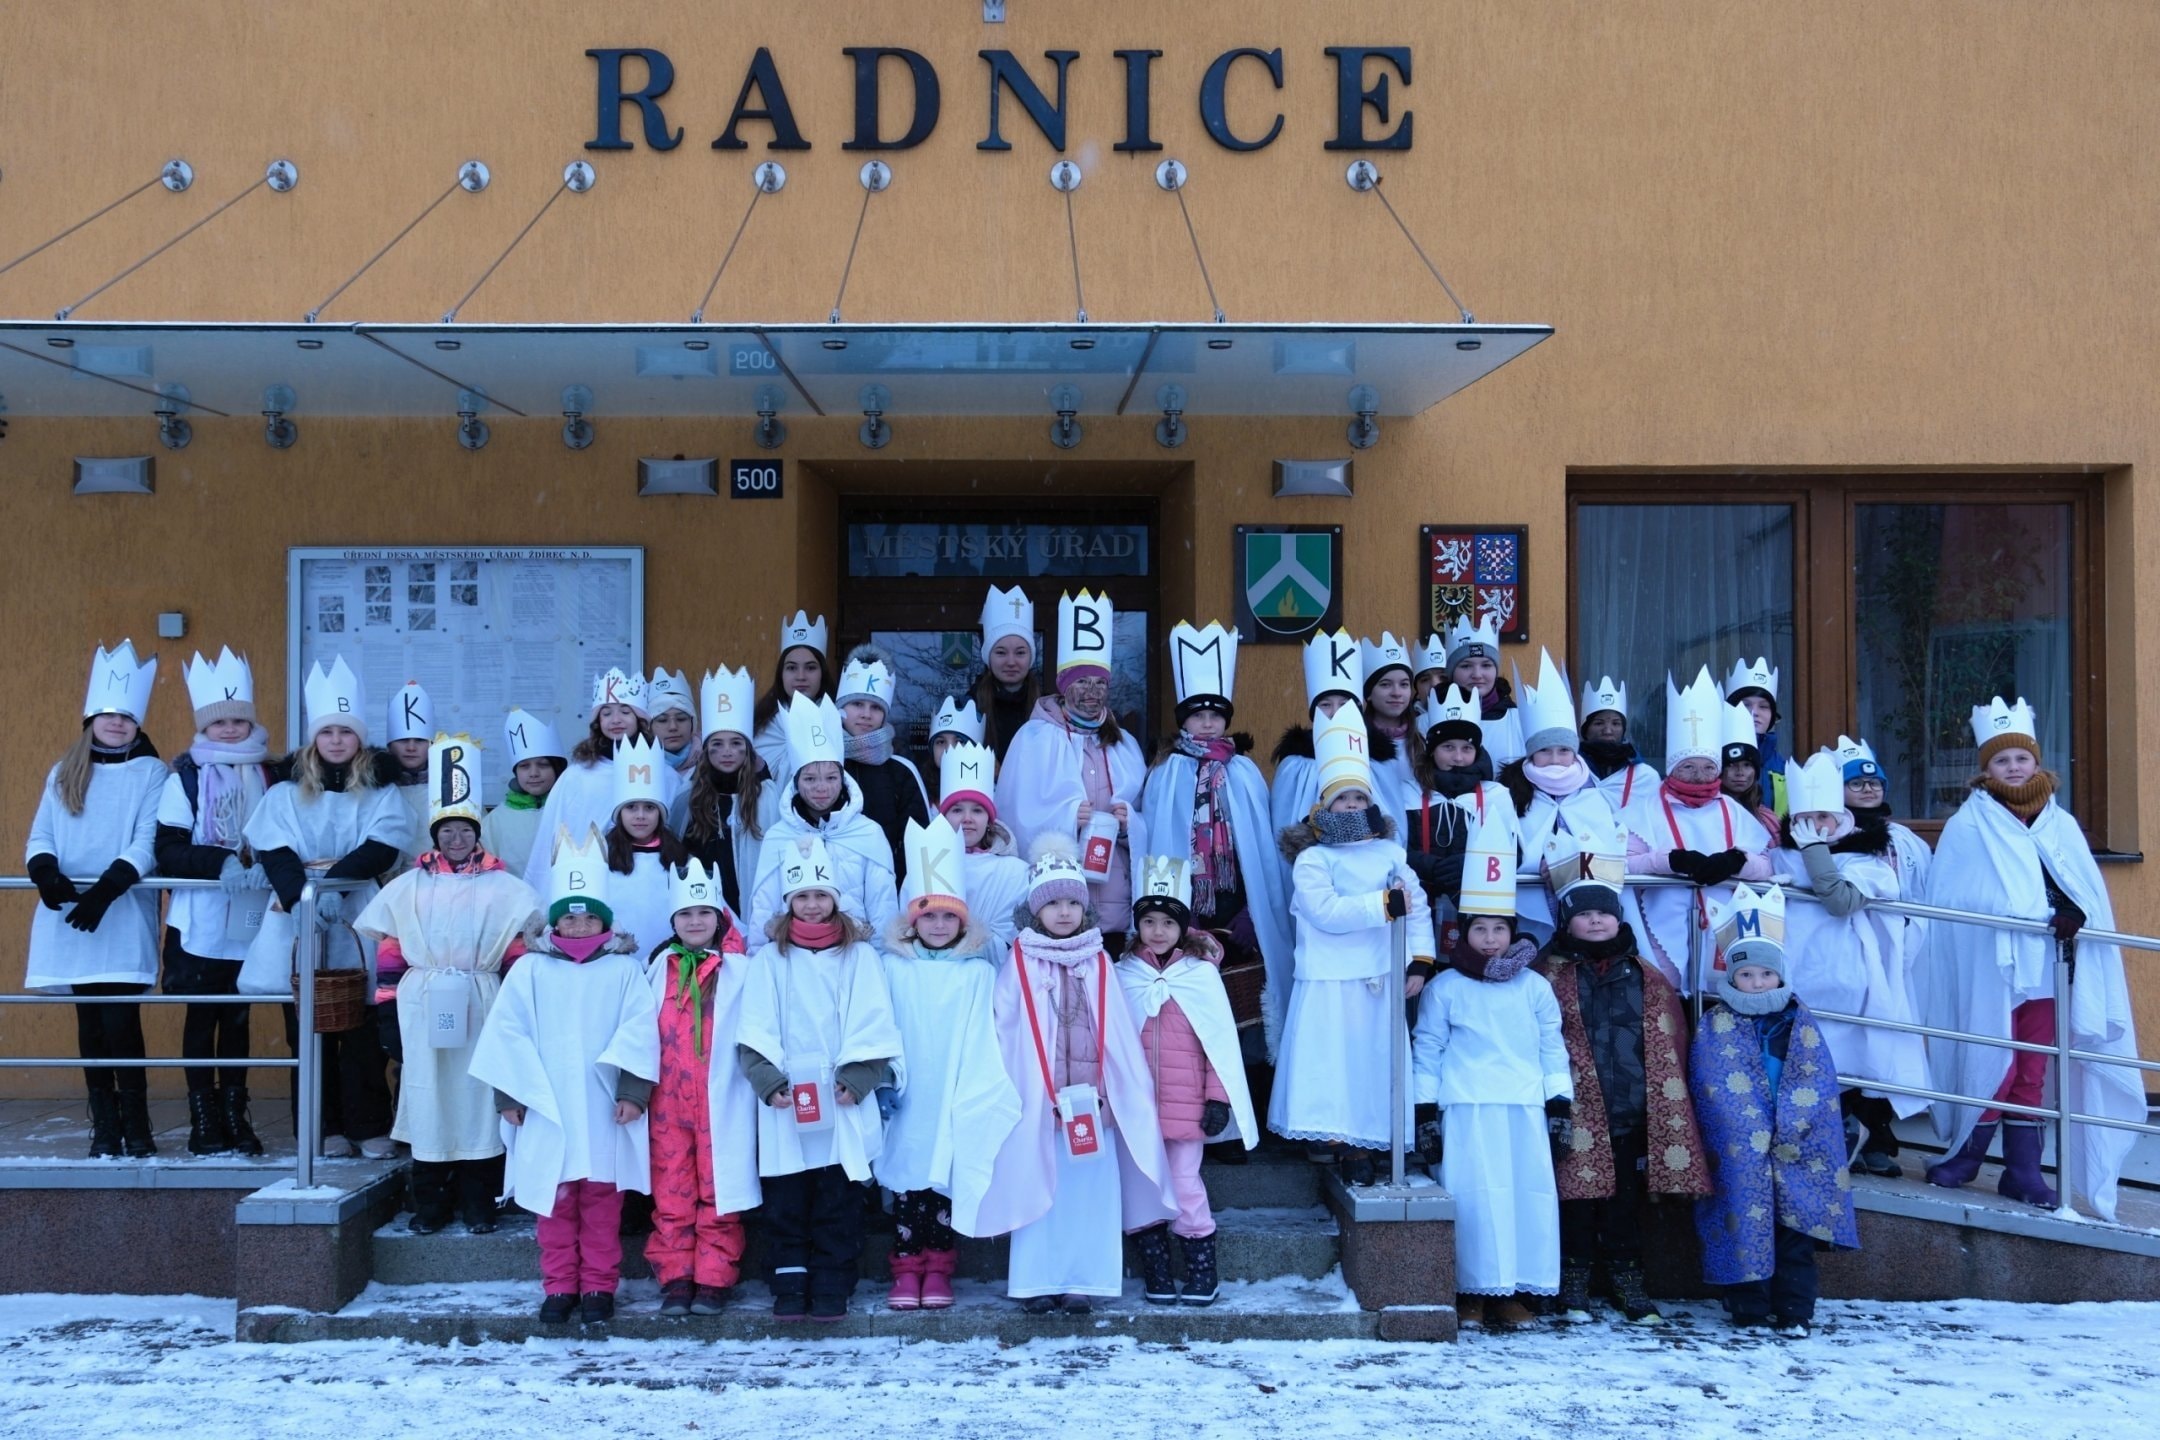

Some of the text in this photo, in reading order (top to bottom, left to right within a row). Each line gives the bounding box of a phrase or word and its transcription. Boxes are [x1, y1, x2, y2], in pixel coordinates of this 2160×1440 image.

[584, 47, 1413, 151] RADNICE
[737, 468, 776, 490] 500
[343, 549, 382, 559] ÚŘEDNÍ
[387, 551, 420, 559] DESKA
[424, 549, 485, 559] MĚSTSKÉHO
[489, 549, 524, 559] ÚŘADU
[864, 528, 1135, 559] MĚSTSKÝ ÚŘAD
[1073, 605, 1104, 651] B
[1178, 636, 1223, 697] M
[1331, 641, 1355, 680] K
[108, 669, 131, 694] M
[225, 686, 238, 701] K
[606, 677, 620, 703] K
[866, 674, 880, 692] K
[338, 697, 351, 713] B
[404, 693, 426, 731] K
[718, 693, 732, 712] B
[509, 723, 527, 755] M
[811, 725, 827, 747] B
[1349, 734, 1362, 754] M
[441, 746, 470, 808] B
[628, 765, 652, 783] M
[961, 762, 978, 779] M
[816, 865, 830, 880] K
[922, 846, 955, 895] K
[1487, 856, 1501, 882] B
[1580, 852, 1595, 880] K
[569, 871, 586, 890] B
[1736, 908, 1761, 939] M
